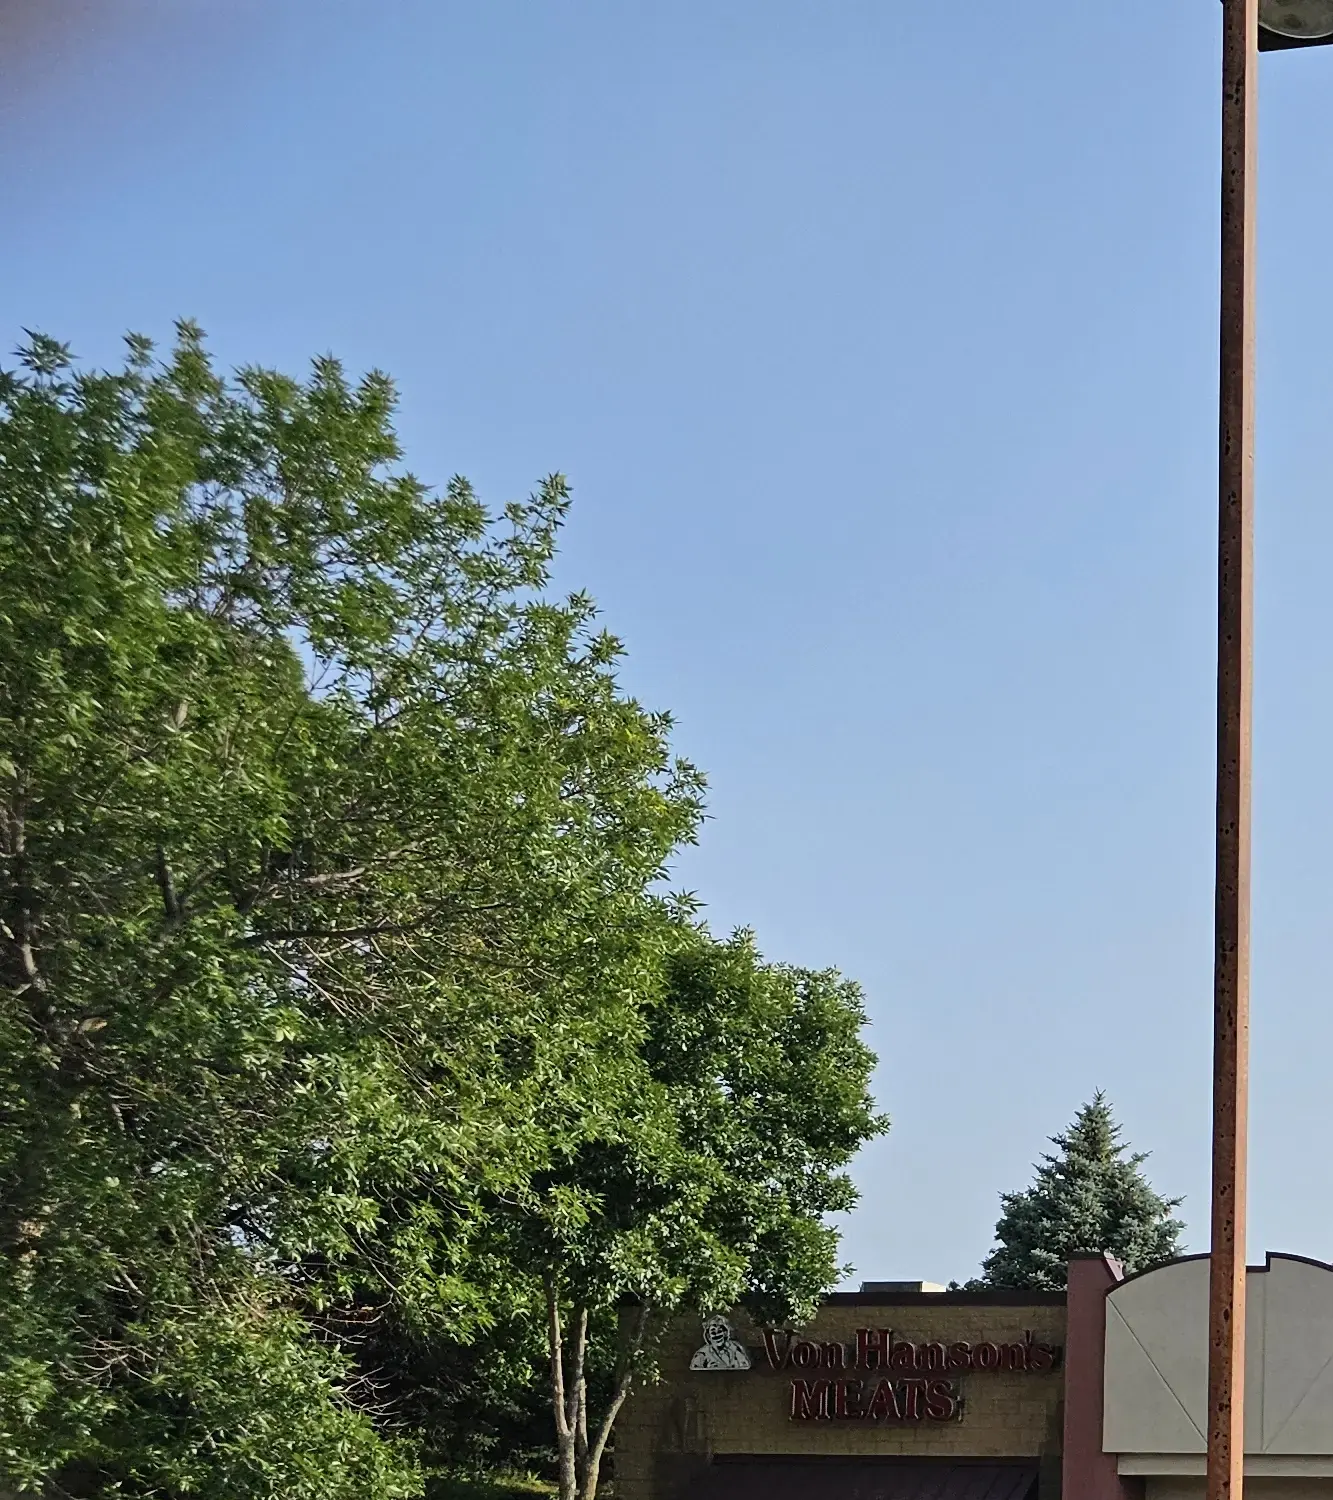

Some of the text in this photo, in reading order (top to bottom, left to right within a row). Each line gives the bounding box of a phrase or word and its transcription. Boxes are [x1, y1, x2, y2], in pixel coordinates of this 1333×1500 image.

[762, 1327, 1056, 1372] Von Hanson's
[788, 1377, 960, 1422] MEATS
